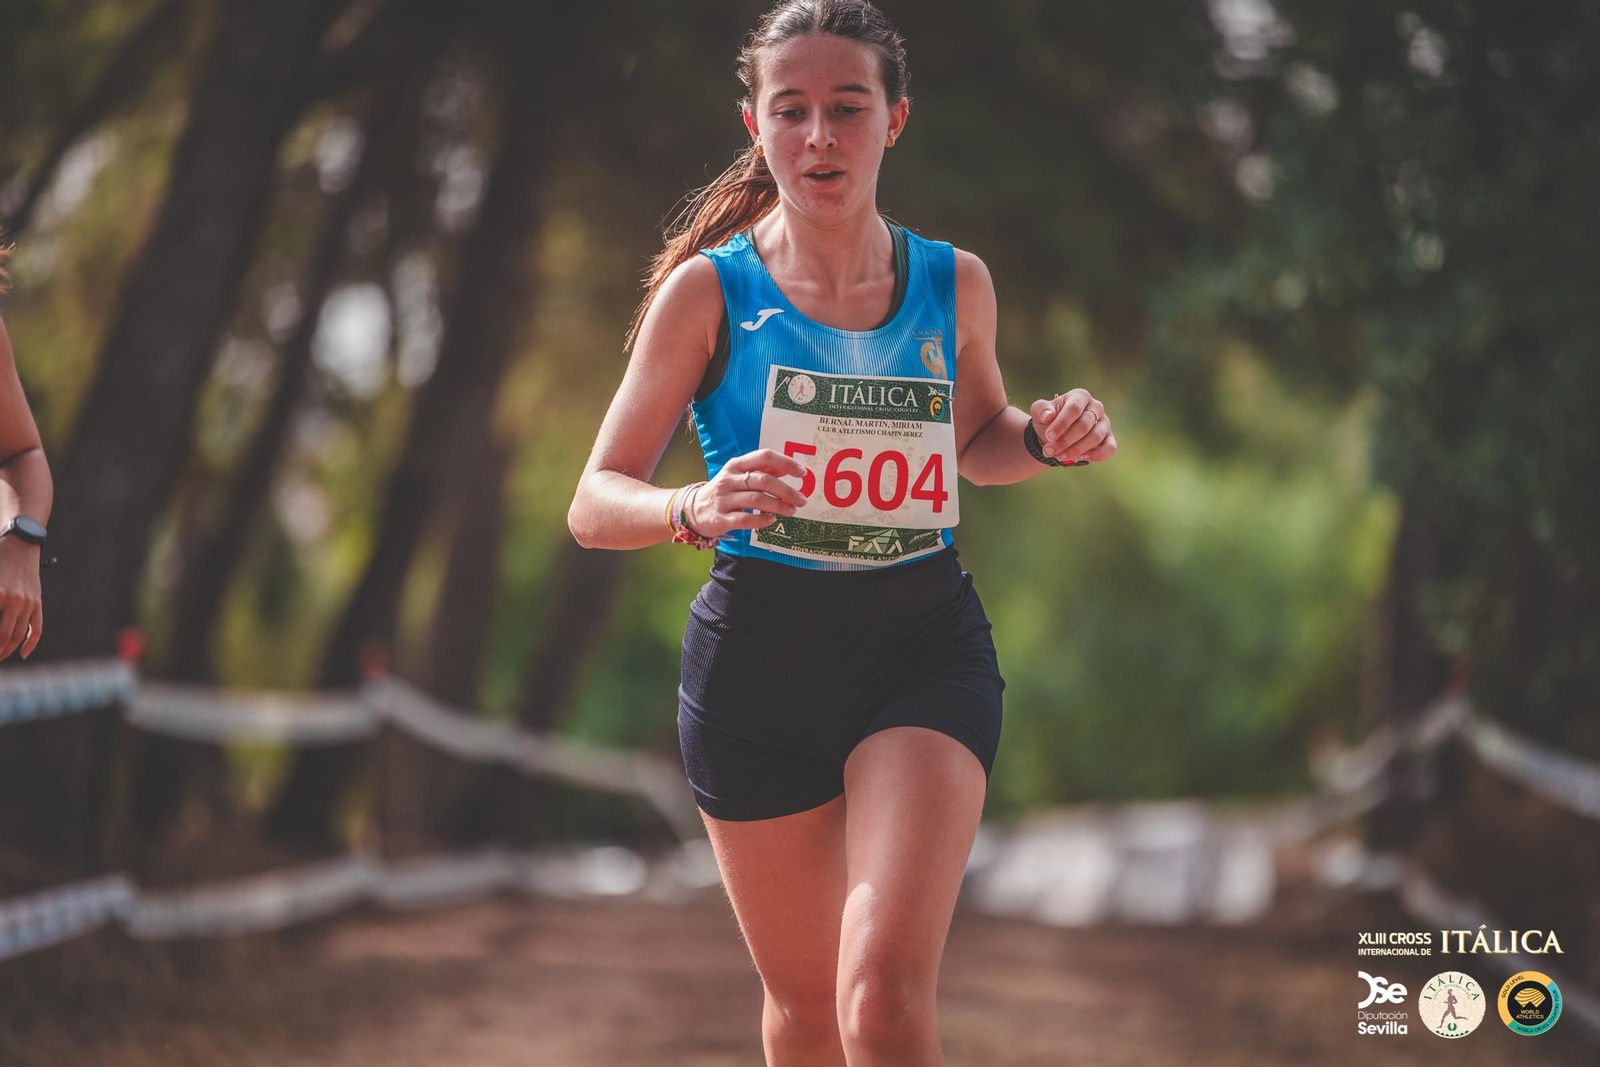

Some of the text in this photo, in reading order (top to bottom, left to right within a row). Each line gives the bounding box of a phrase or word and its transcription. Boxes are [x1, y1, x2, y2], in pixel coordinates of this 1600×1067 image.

[829, 381, 919, 407] ITÁLICA
[828, 404, 874, 412] INTERNATIONAL
[819, 417, 853, 427] BERNAL
[892, 421, 923, 430] MIRIAM
[817, 425, 836, 433] CLUB
[837, 427, 876, 436] ATLETISMO
[902, 430, 923, 438] JEREZ
[784, 441, 948, 513] 5604
[791, 545, 829, 556] FEDERACIÓN
[831, 551, 865, 560] ANDALUZA
